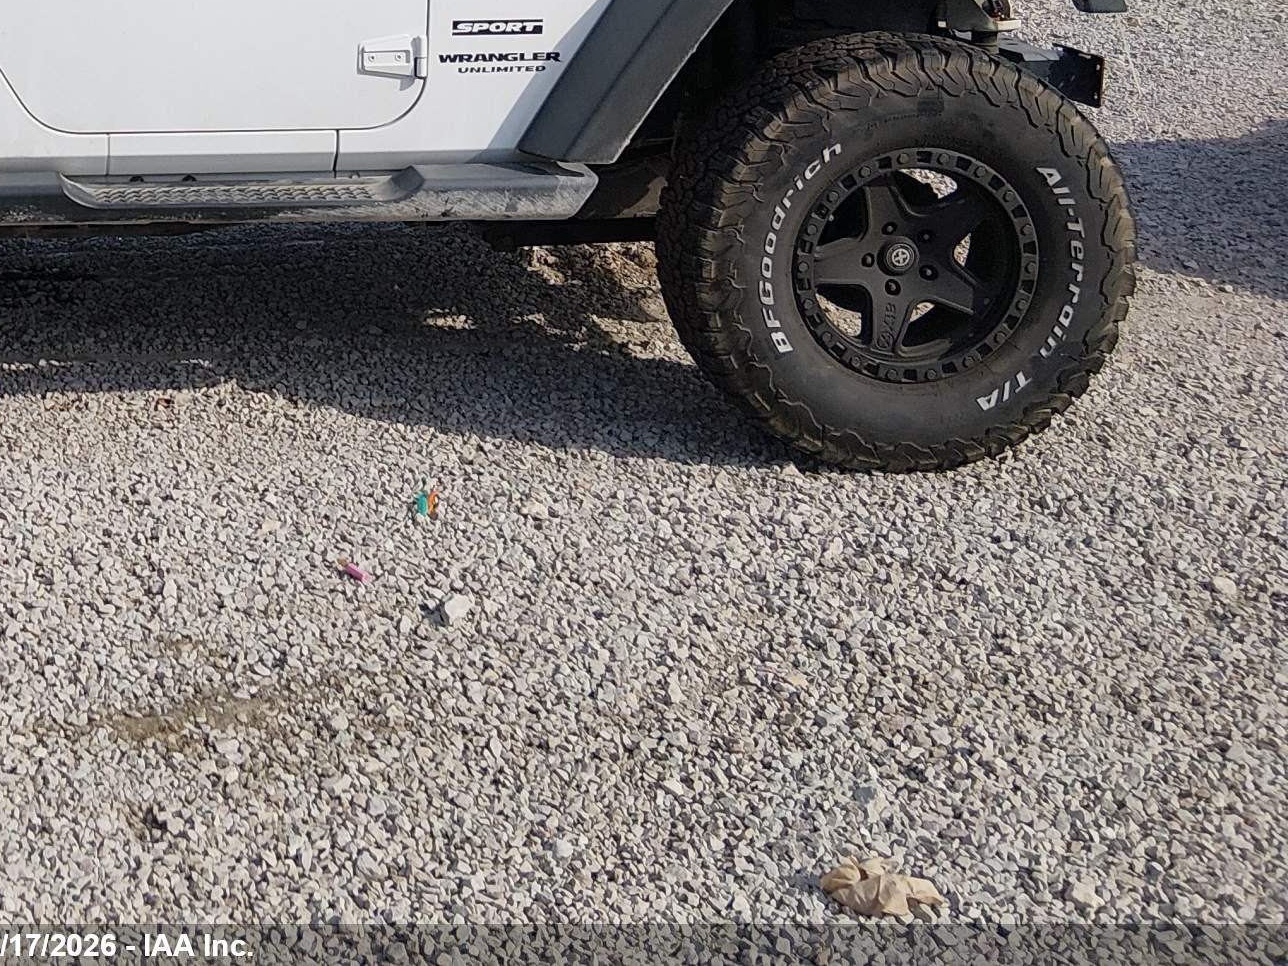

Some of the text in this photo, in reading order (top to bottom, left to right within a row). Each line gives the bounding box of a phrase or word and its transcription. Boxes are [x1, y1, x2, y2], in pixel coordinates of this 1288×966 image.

[454, 20, 543, 34] SPORT
[439, 51, 561, 63] WRANGLER
[458, 65, 546, 74] UNLIMITED
[758, 143, 842, 354] BFGoodrich
[976, 166, 1086, 412] All-Terrain T/A
